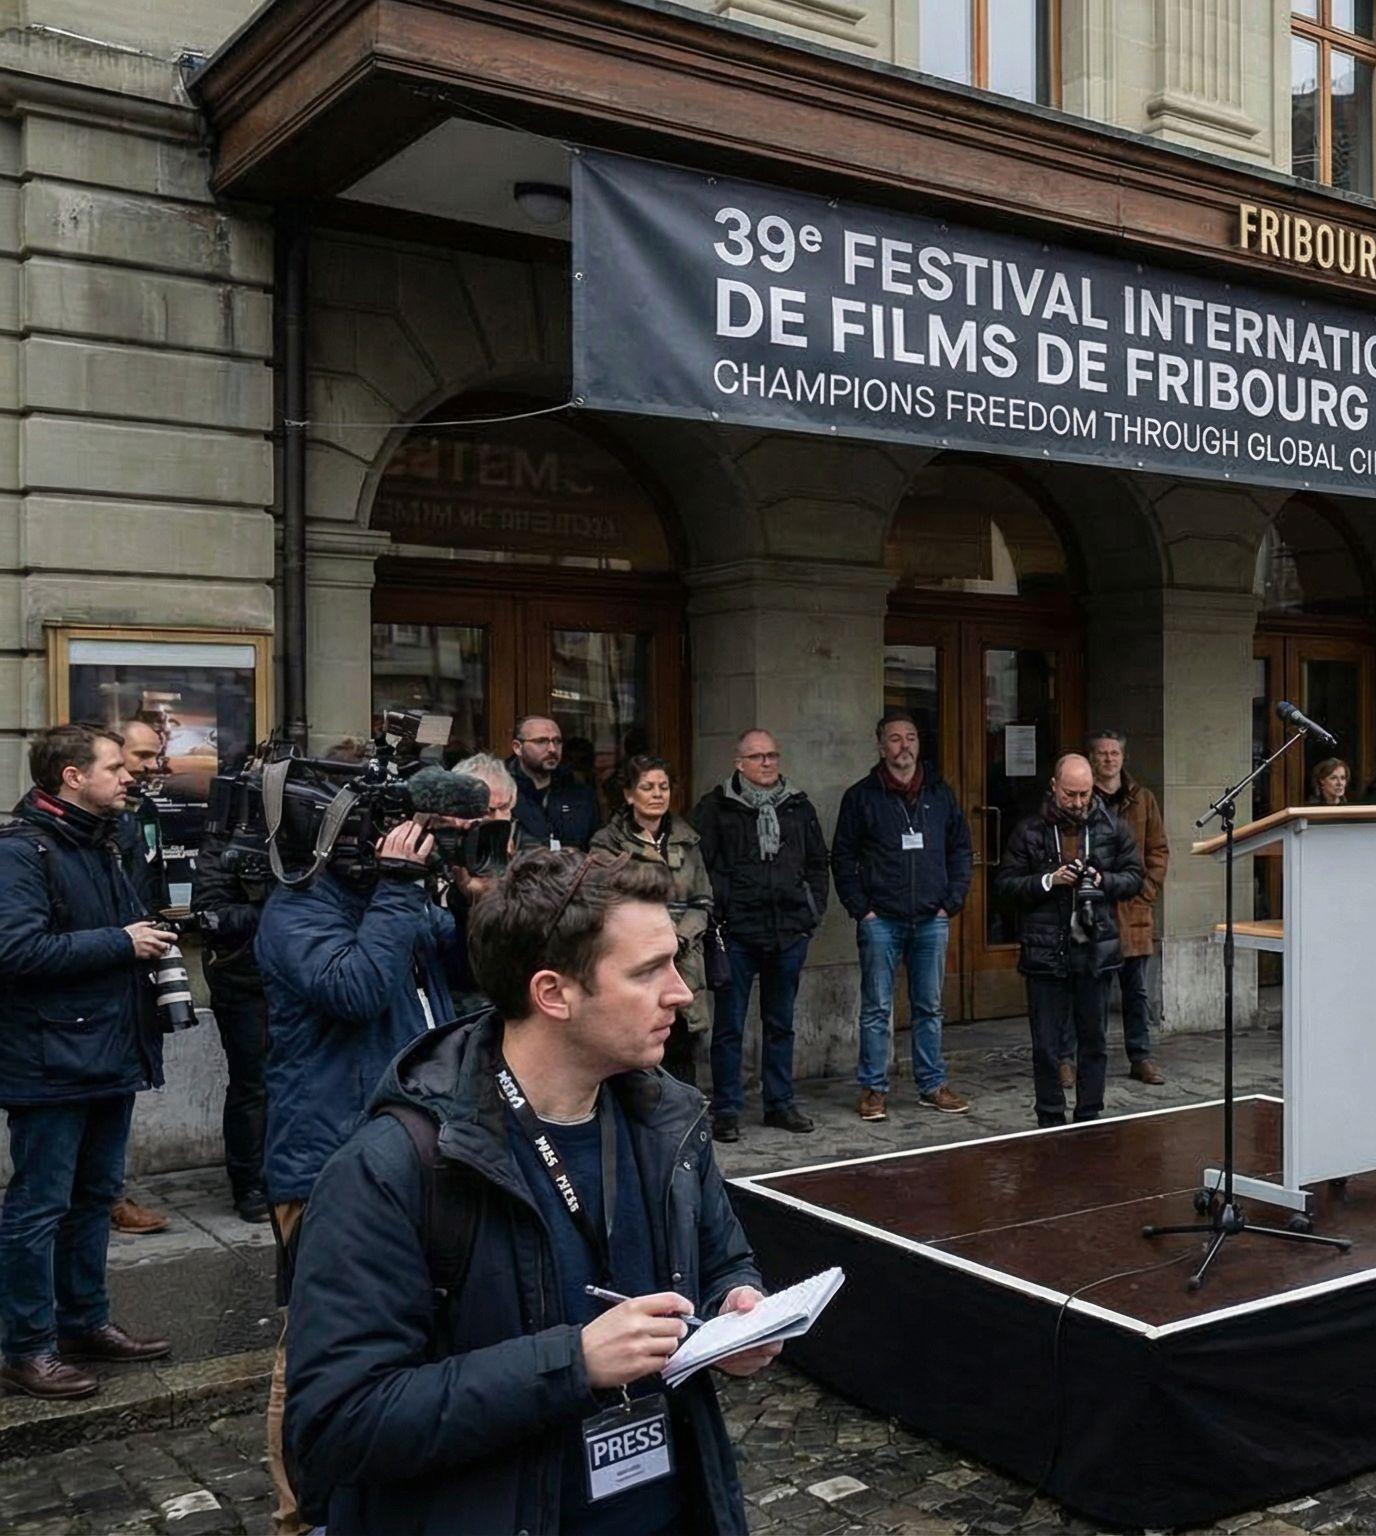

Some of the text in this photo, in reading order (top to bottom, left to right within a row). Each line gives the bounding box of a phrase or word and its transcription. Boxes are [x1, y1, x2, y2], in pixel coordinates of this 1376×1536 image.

[843, 229, 1110, 331] FESTIVAL
[715, 277, 1370, 431] DE FILMS DE FRIBOURG
[712, 359, 937, 419] CHAMPIONS
[946, 389, 1098, 441] FREEDOM
[1103, 411, 1240, 458] THROUGH
[1247, 432, 1344, 473] GLOBAL
[592, 1421, 664, 1467] PRESS
